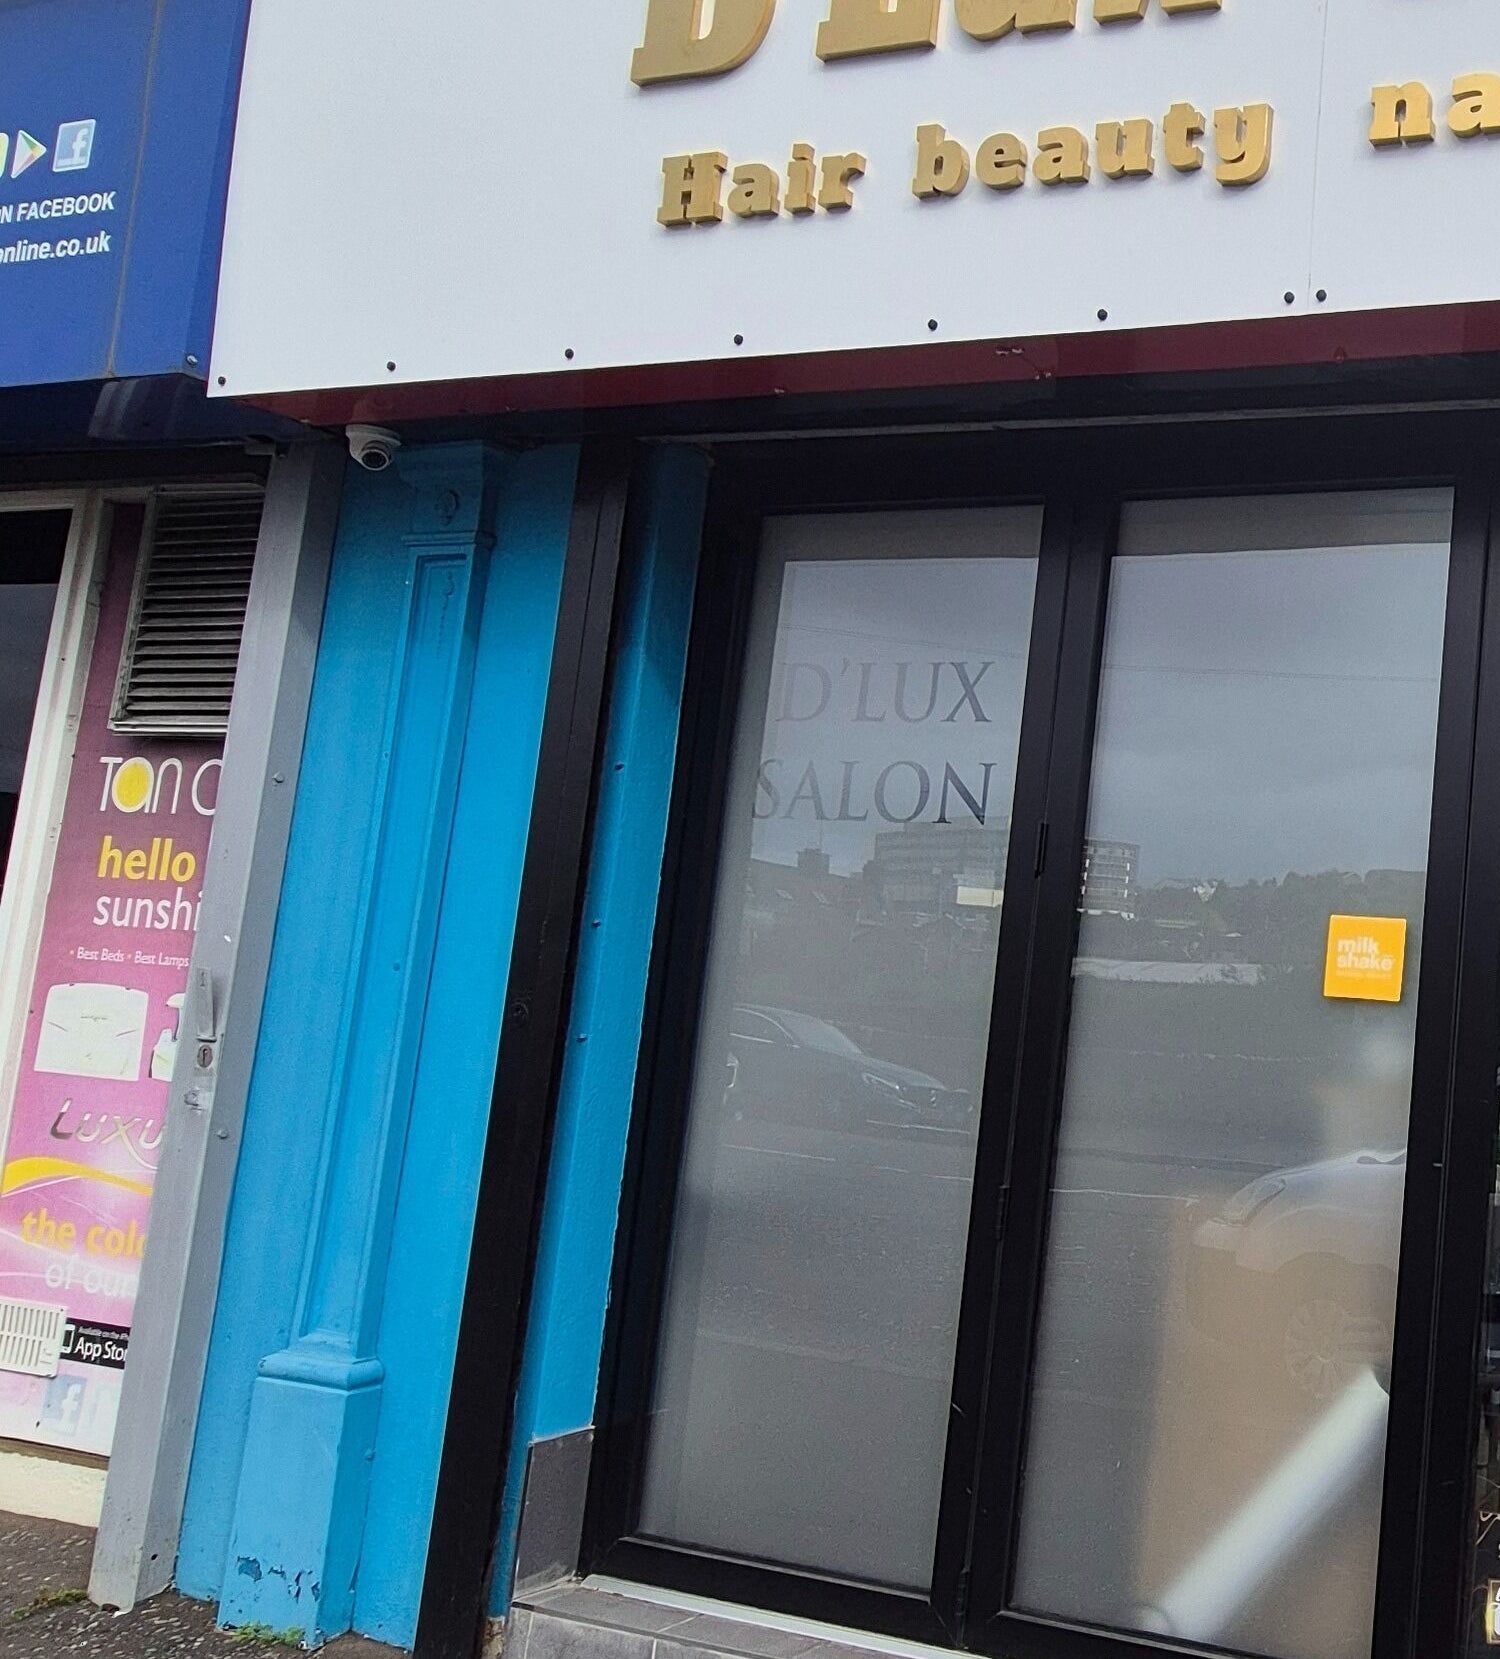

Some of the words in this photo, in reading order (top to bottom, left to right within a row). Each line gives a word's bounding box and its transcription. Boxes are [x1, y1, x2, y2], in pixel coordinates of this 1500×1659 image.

[656, 143, 868, 229] Hair
[911, 102, 1275, 201] beauty
[0, 205, 13, 224] N
[16, 191, 116, 222] FACEBOOK
[0, 230, 112, 264] nline.co.uk
[775, 657, 996, 723] D'LUX
[751, 758, 998, 825] SALON
[97, 835, 196, 883] hello
[77, 947, 99, 960] Best
[101, 949, 124, 962] Beds
[134, 951, 156, 964] Best
[158, 952, 190, 969] Lamps
[1336, 952, 1393, 971] shake
[1337, 936, 1379, 954] milk
[21, 1207, 77, 1250] the
[74, 1337, 102, 1361] App
